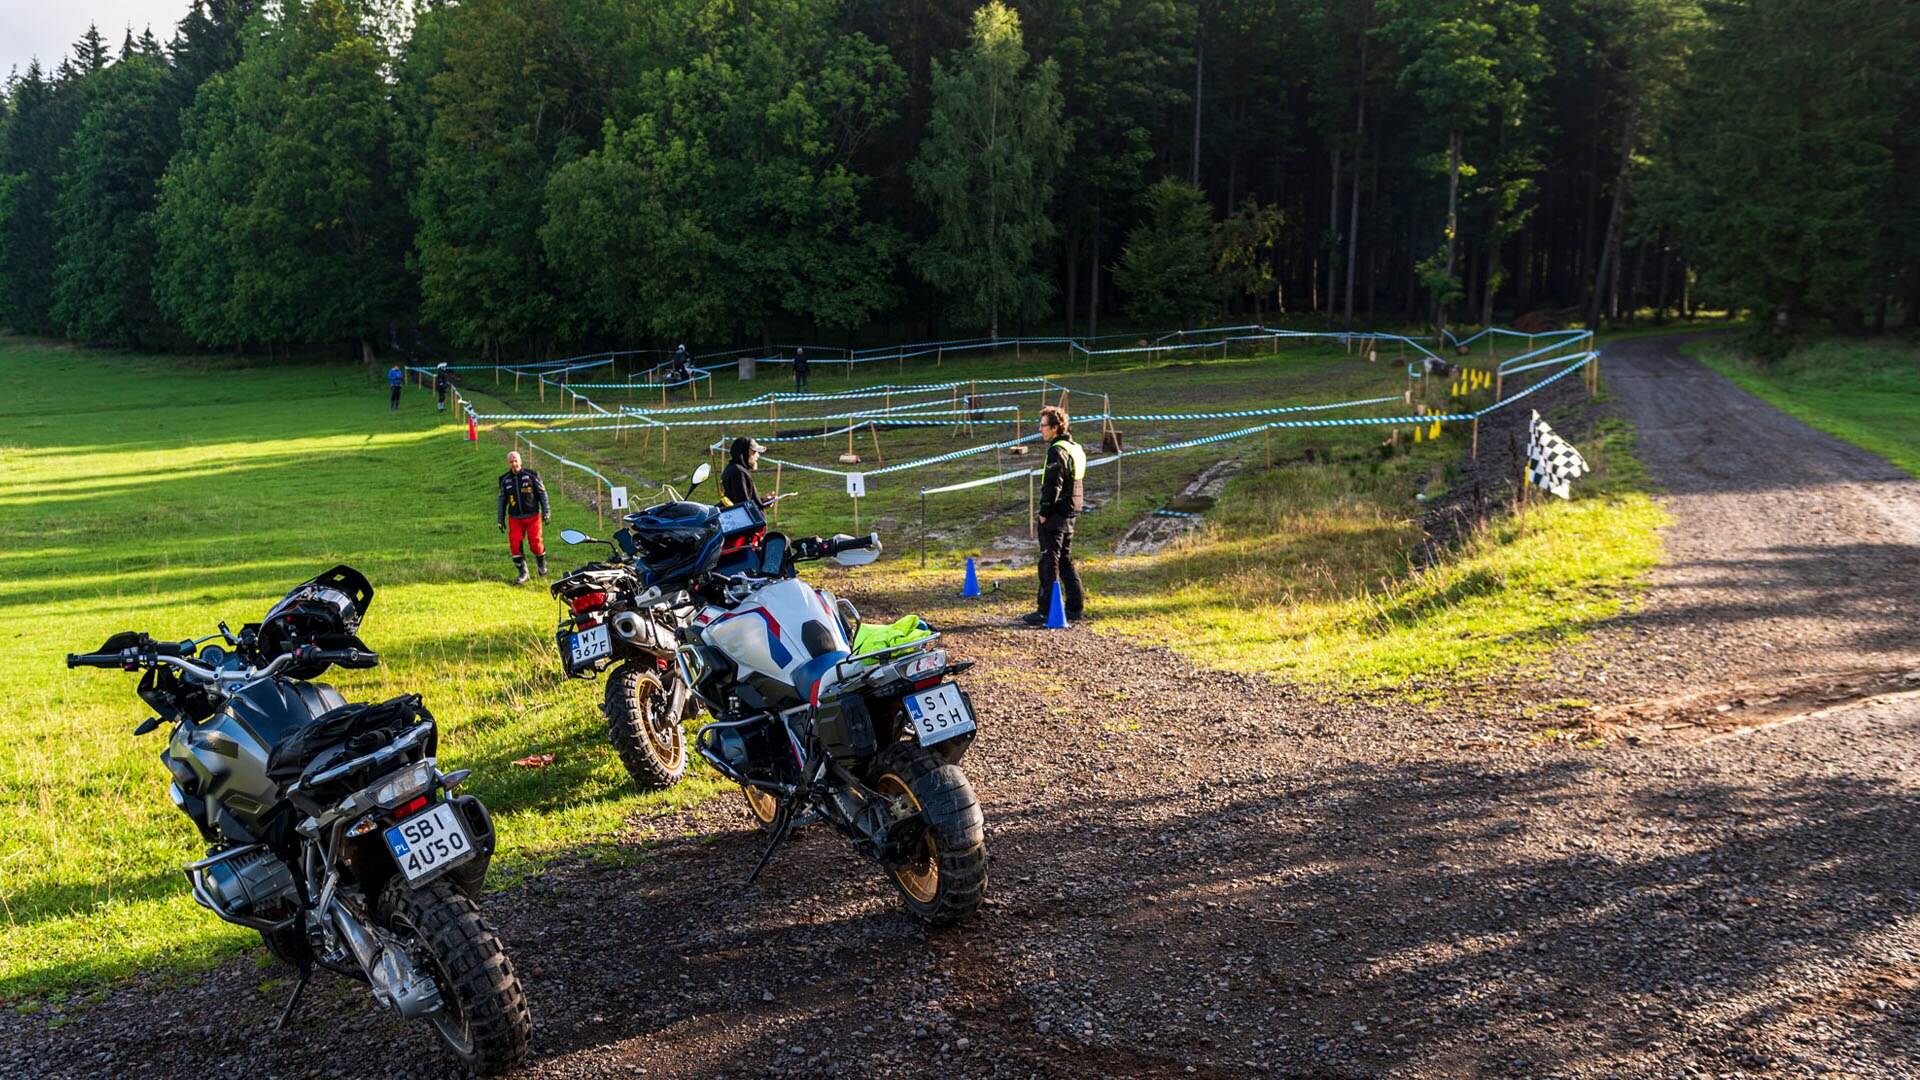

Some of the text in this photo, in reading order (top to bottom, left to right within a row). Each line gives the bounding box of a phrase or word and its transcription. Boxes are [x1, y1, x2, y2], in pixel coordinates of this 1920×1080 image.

[582, 631, 597, 644] WY
[575, 640, 607, 660] 367F
[924, 691, 948, 711] S1
[922, 707, 962, 732] SSH
[394, 844, 409, 855] PL
[408, 832, 464, 872] 4U50
